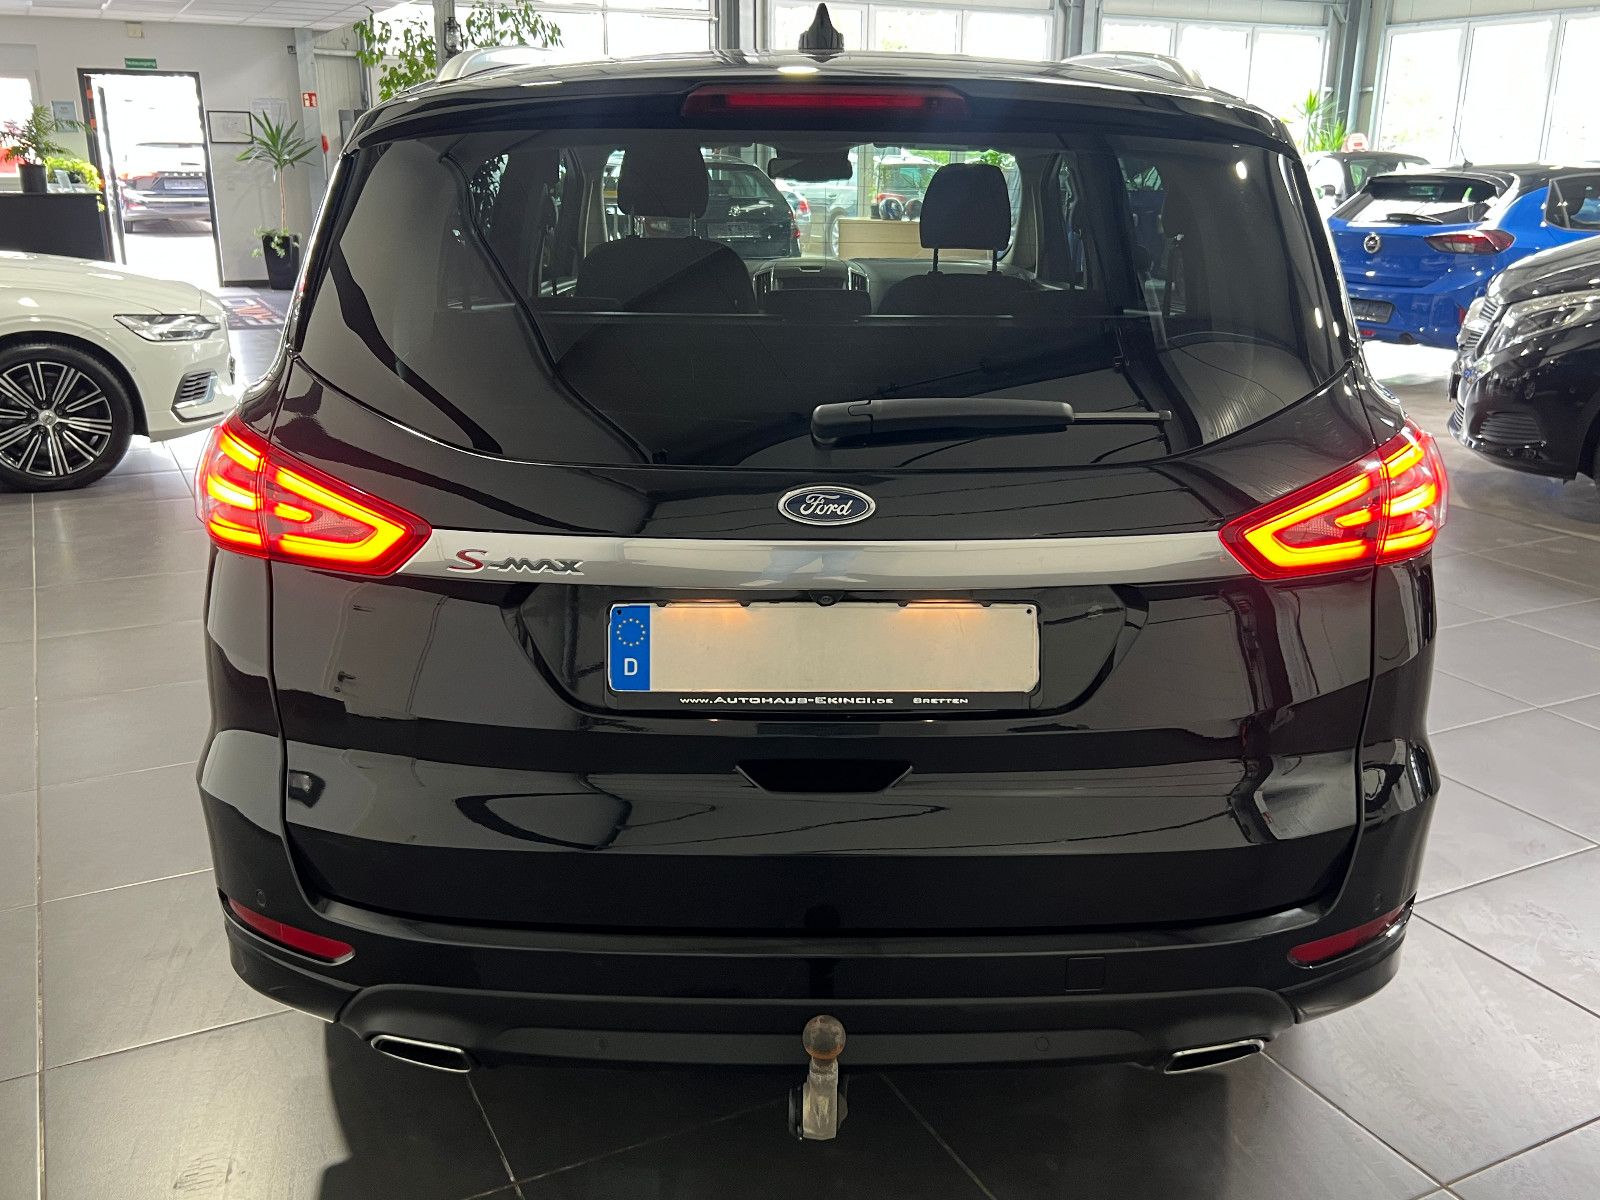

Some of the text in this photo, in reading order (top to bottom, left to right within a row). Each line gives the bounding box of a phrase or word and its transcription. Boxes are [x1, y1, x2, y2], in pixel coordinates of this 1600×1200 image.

[800, 493, 853, 516] Ford
[447, 548, 584, 575] S-MAX
[623, 657, 639, 676] D
